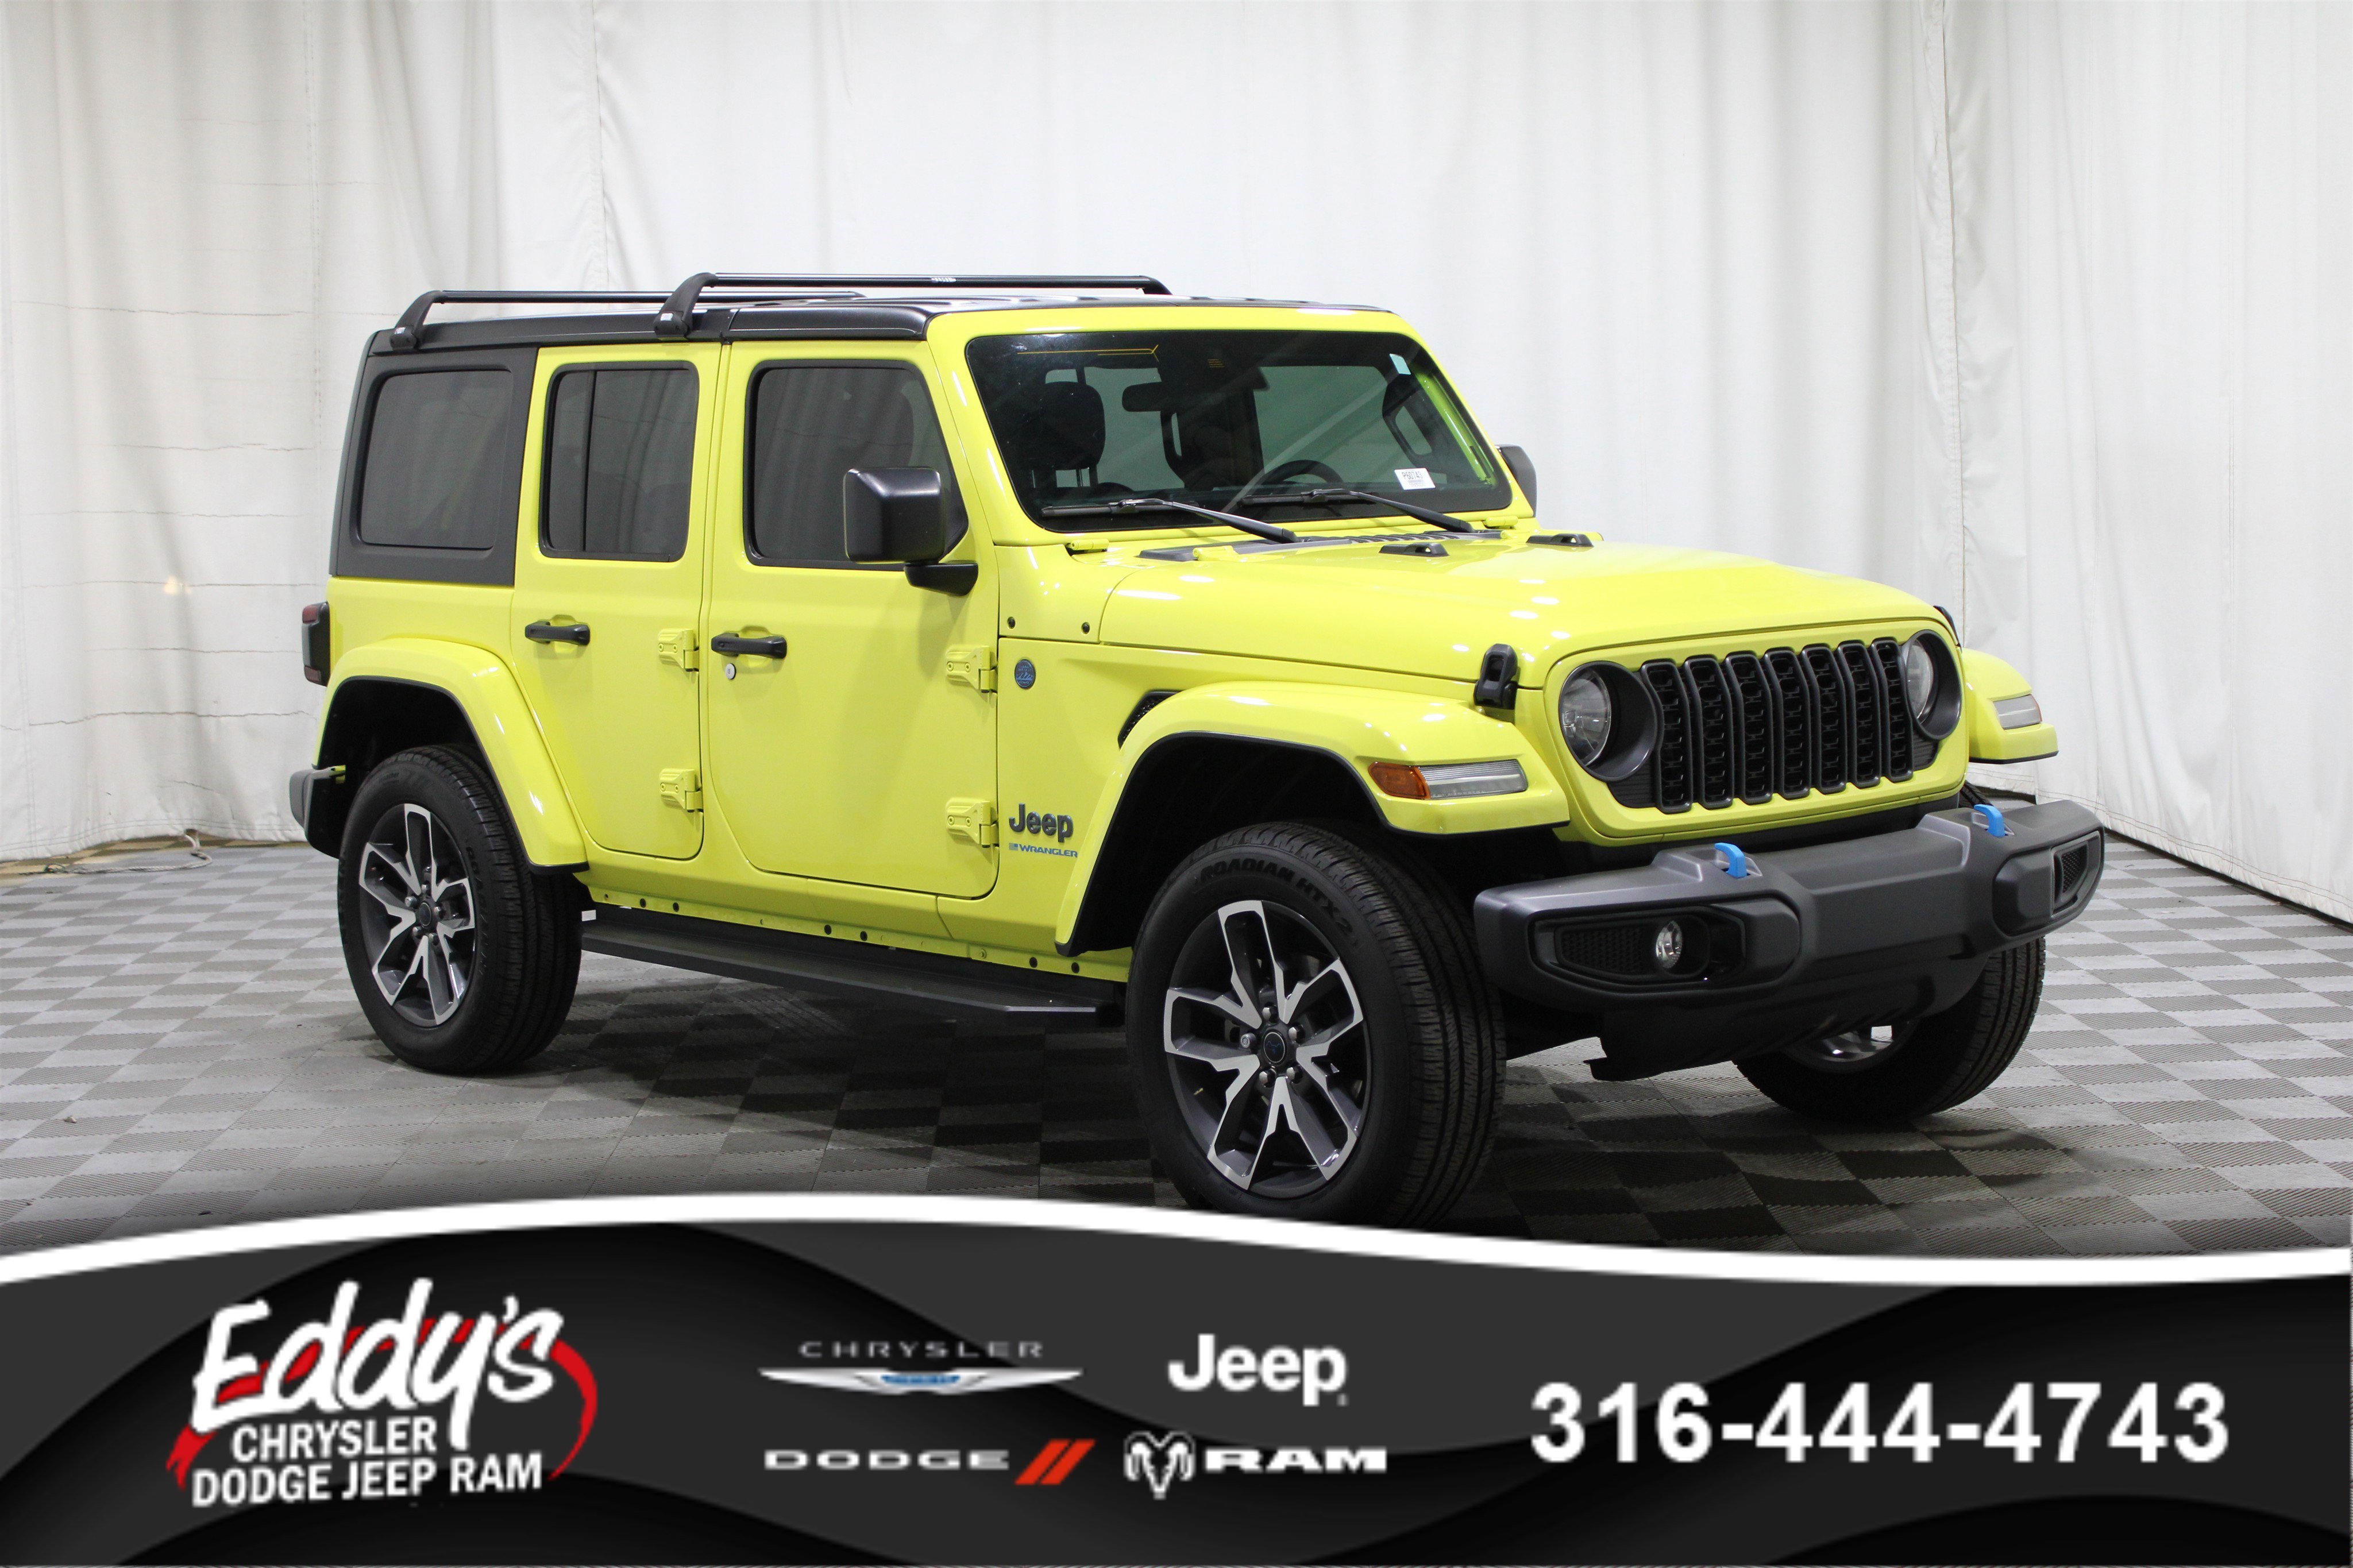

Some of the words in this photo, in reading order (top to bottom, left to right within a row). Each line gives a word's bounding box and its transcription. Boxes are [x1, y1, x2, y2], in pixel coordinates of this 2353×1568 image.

[1009, 803, 1074, 843] Jeep
[1019, 843, 1078, 858] WRANGLER
[1200, 858, 1295, 882] ROADIAN
